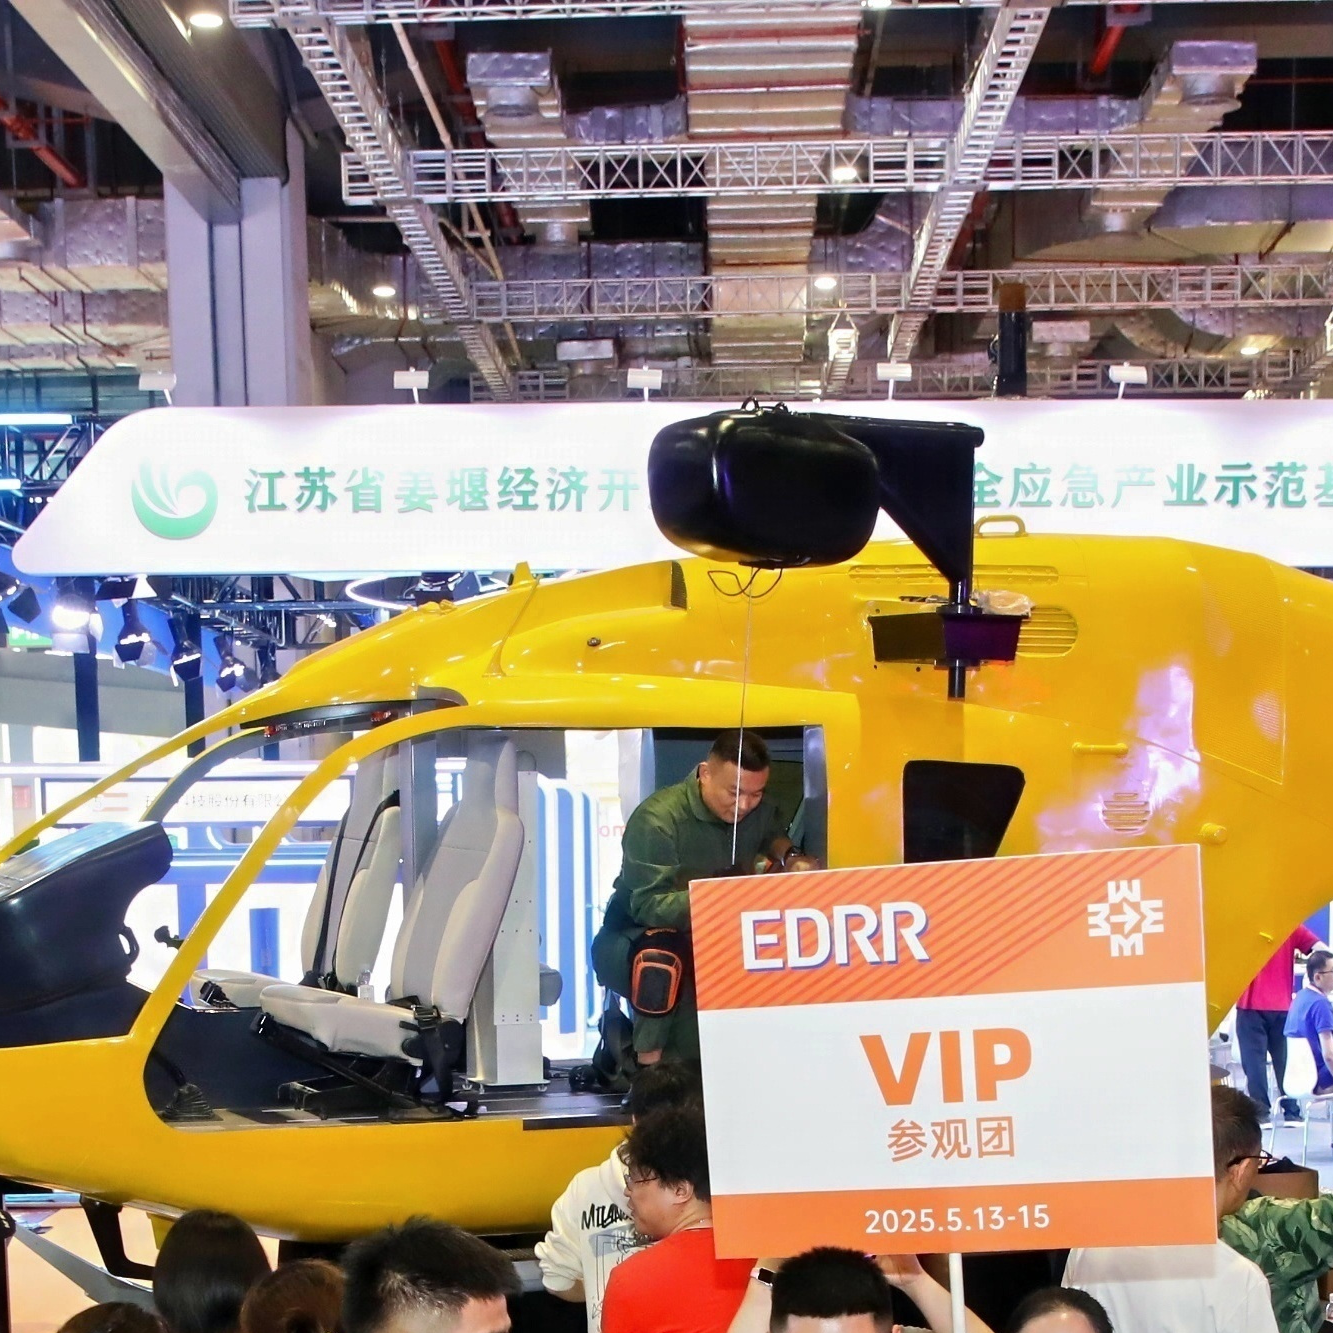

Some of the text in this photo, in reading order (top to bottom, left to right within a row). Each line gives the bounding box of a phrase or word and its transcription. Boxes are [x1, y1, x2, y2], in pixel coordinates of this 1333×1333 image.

[244, 465, 643, 513] 江苏省姜堰经济开
[740, 901, 930, 972] EDRR
[859, 1027, 1032, 1106] VIP
[886, 1115, 1016, 1162] 参观团
[865, 1204, 1050, 1235] 2025.5.13-15
